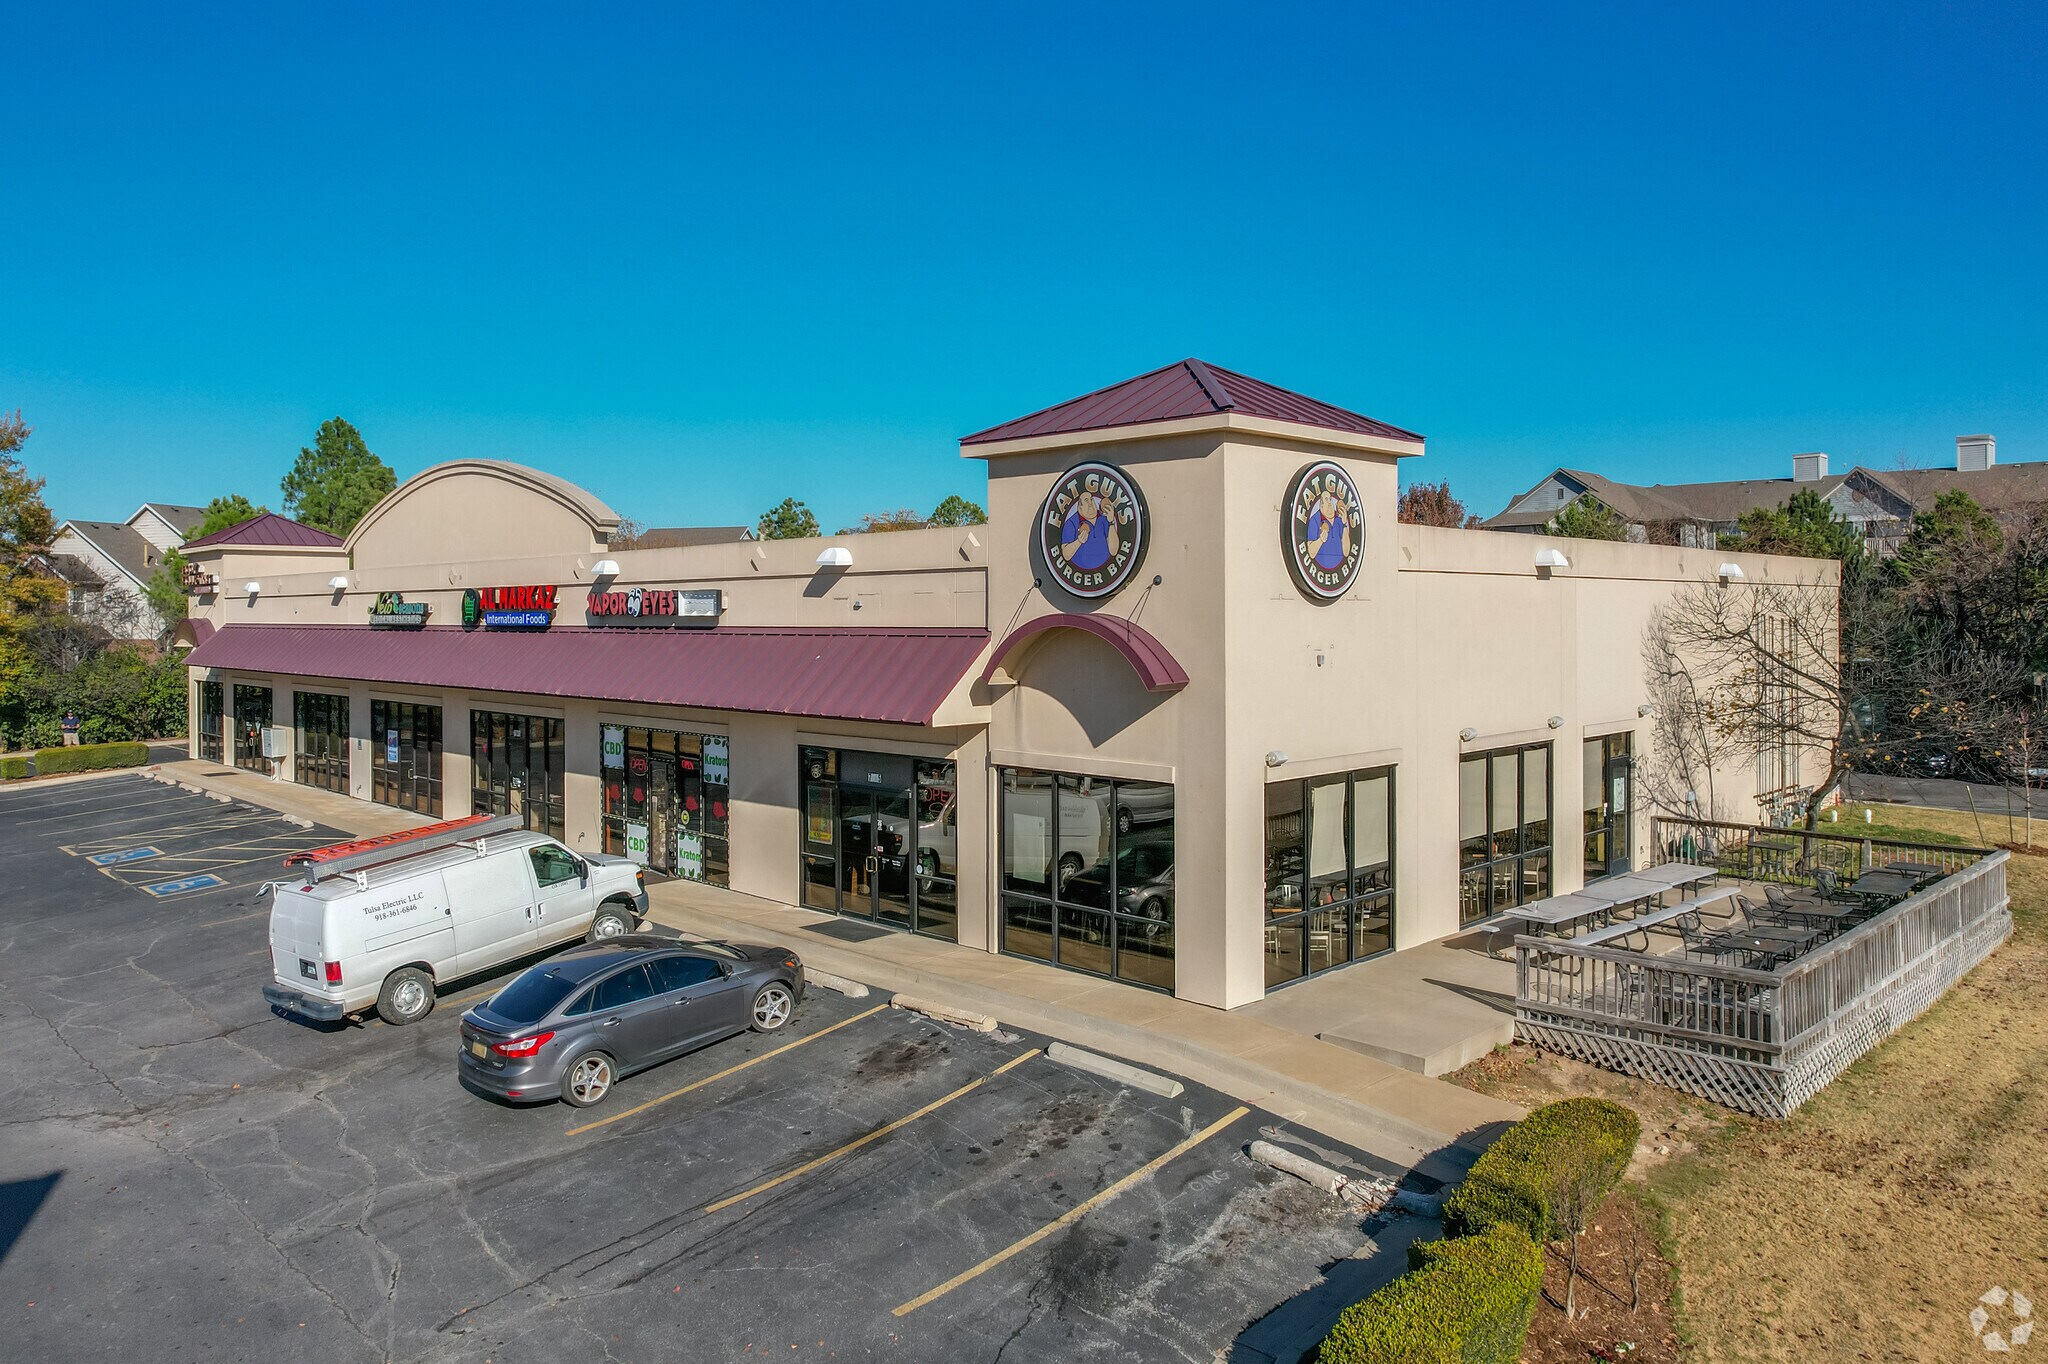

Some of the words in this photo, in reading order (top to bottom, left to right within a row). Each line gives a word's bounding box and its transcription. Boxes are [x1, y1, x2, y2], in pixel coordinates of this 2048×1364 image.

[1048, 479, 1080, 528] FAT
[1085, 474, 1134, 525] GUY'S
[1296, 475, 1321, 525] FAT
[1325, 473, 1360, 529] GUY'S
[1050, 544, 1104, 586] BURGER
[1107, 540, 1132, 577] BAR
[1298, 541, 1339, 586] BURGER
[1341, 543, 1360, 577] BAR
[480, 586, 496, 609] AL
[499, 585, 554, 609] MARKAZ
[587, 592, 628, 616] VAPOR
[642, 591, 675, 616] EYES
[486, 613, 525, 624] International
[525, 613, 546, 624] Foods
[604, 741, 621, 756] CBD
[630, 758, 648, 771] OPEN
[627, 836, 646, 852] CBD
[363, 905, 381, 915] Tulsa
[381, 898, 407, 910] Electric
[408, 891, 424, 902] LLC
